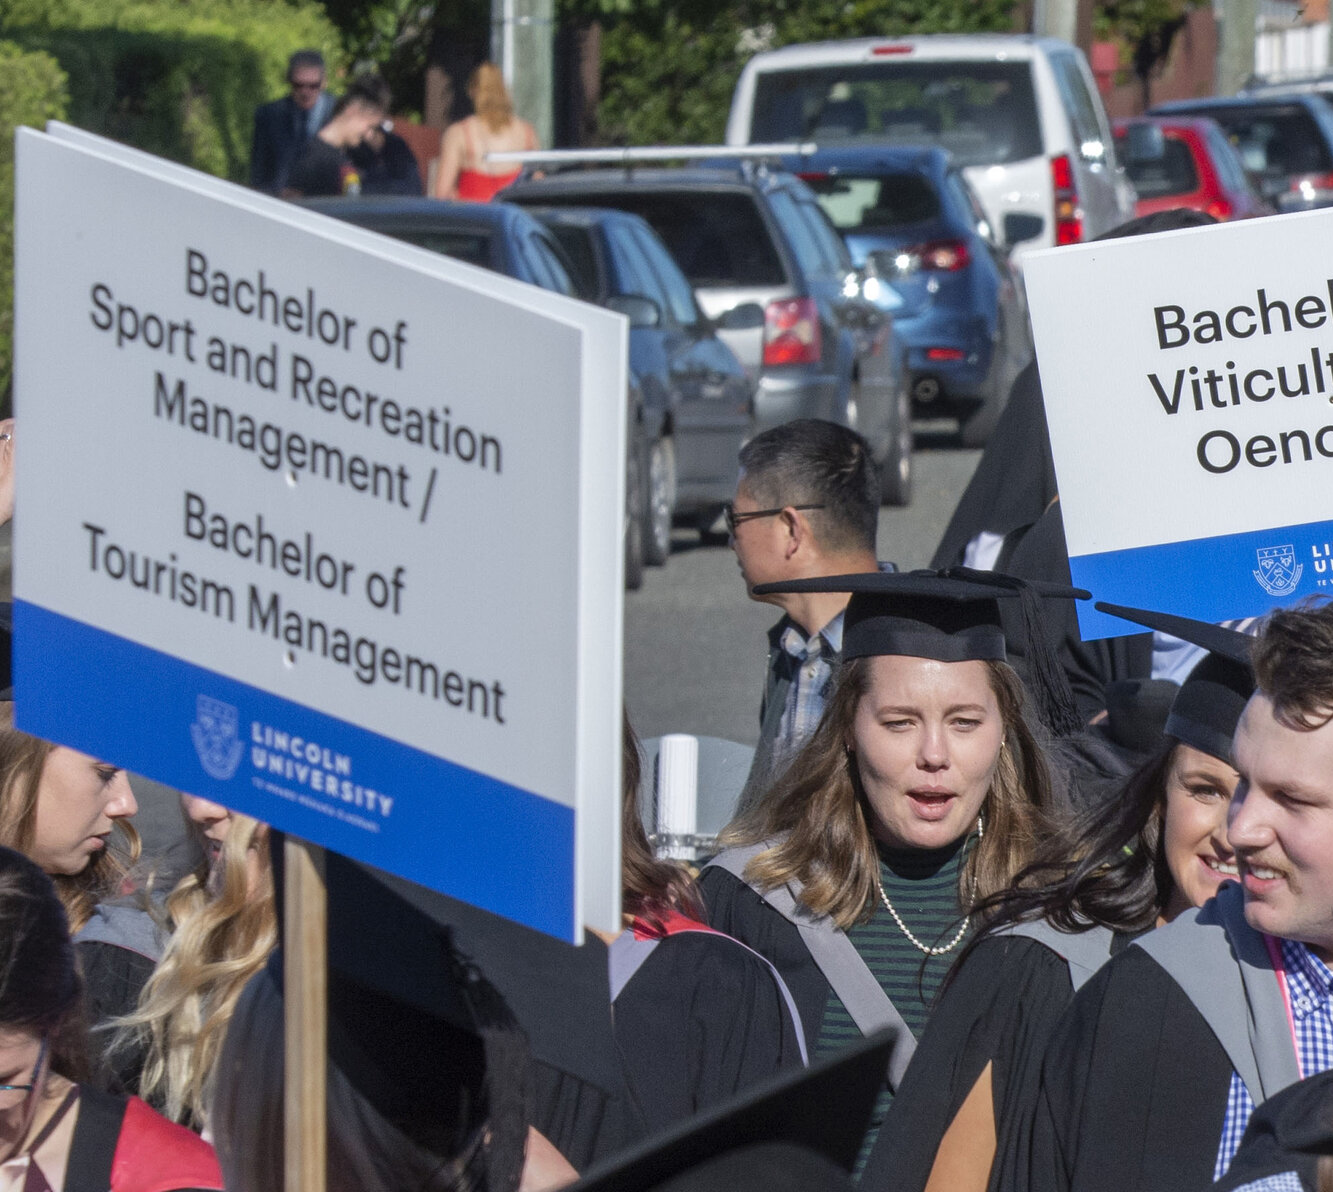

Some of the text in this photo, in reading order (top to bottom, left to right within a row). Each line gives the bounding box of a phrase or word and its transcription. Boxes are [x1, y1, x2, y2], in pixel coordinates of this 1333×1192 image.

[187, 248, 409, 369] Bachelor of
[91, 283, 502, 474] Sport and Recreation
[154, 371, 437, 523] Management /
[184, 491, 406, 616] Bachelor of
[83, 522, 506, 724] Tourism Management
[251, 721, 352, 776] LINCOLN
[251, 747, 394, 817] UNIVERSITY
